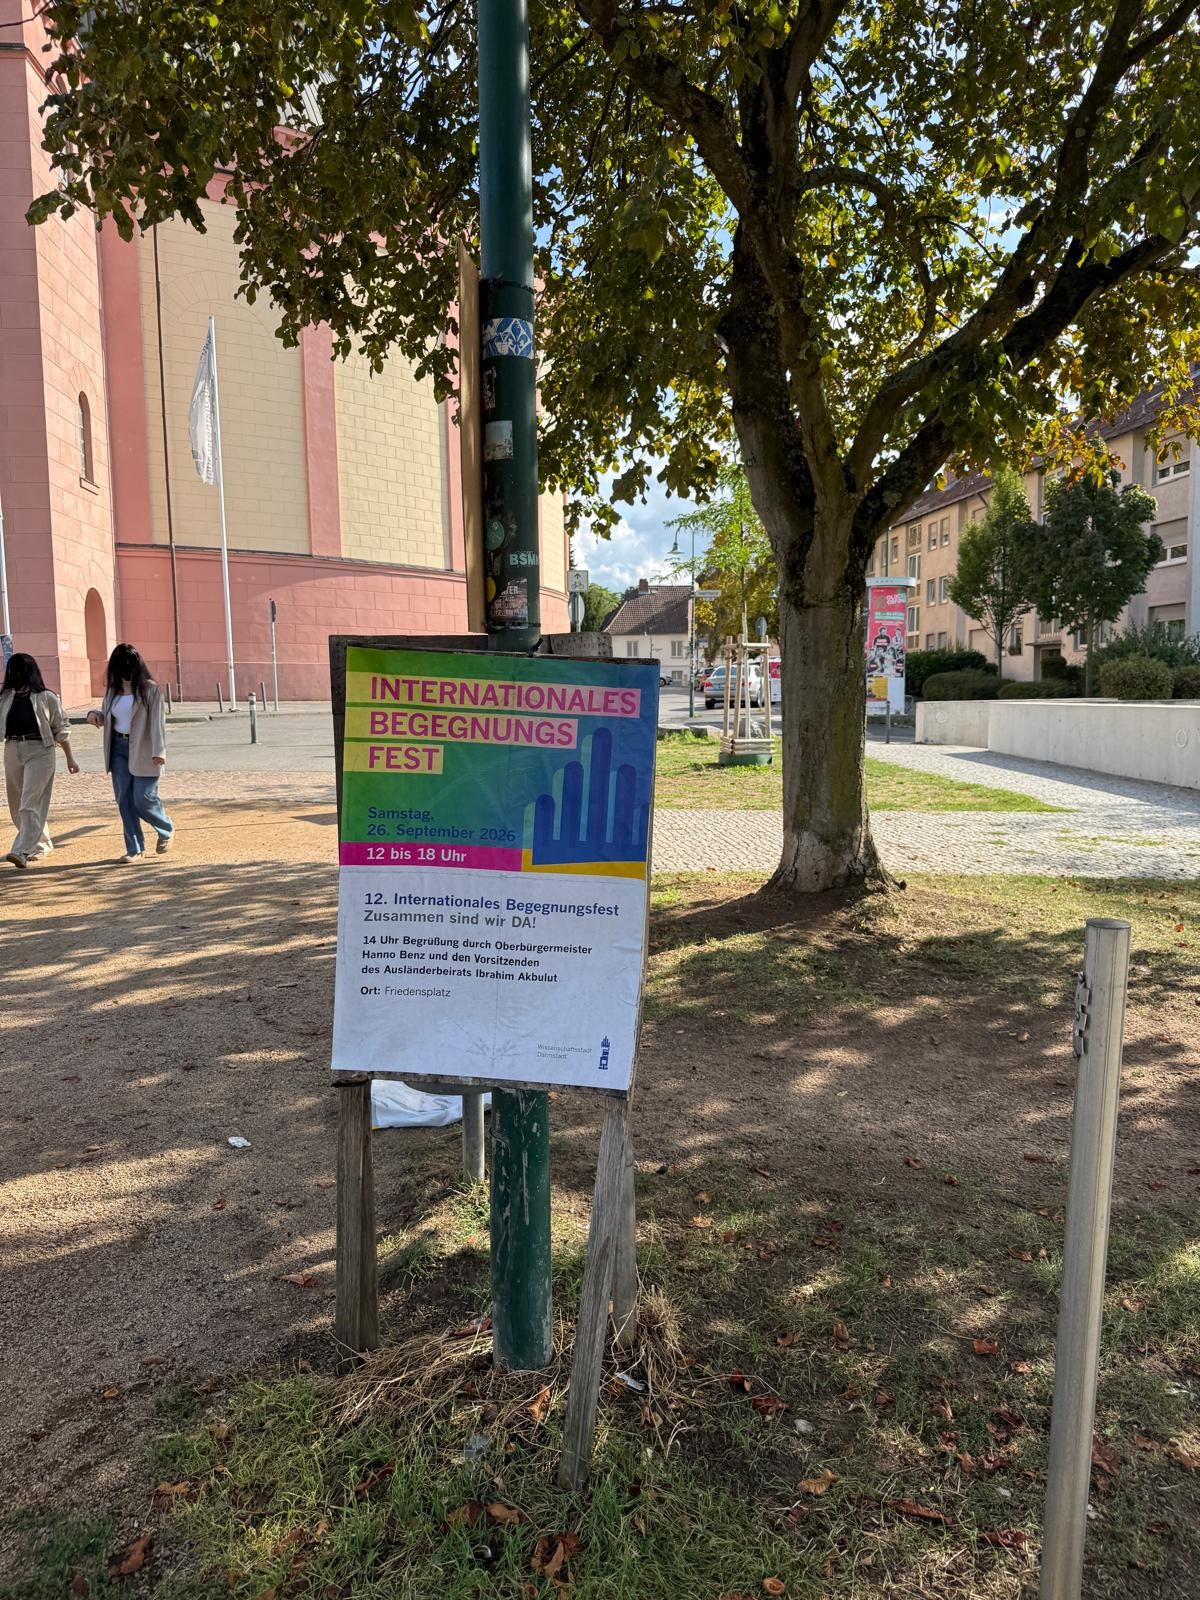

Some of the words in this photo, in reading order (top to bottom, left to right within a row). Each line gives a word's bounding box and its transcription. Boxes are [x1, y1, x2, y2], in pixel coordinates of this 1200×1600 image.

[371, 676, 637, 714] INTERNATIONALES
[370, 711, 573, 746] BEGEGNUNGS
[368, 746, 440, 770] FEST
[368, 806, 434, 823] Samstag,
[367, 824, 390, 836] 26.
[396, 824, 475, 839] September
[479, 828, 516, 842] 2026
[366, 848, 385, 860] 12
[390, 848, 412, 860] bis
[417, 848, 436, 860] 18
[441, 848, 467, 862] Uhr
[364, 892, 388, 905] 12.
[394, 892, 500, 910] Internationales
[506, 898, 619, 917] Begegnungsfest
[363, 910, 444, 923] Zusammen
[449, 912, 479, 925] sind
[484, 915, 506, 927] wir
[511, 916, 536, 929] DA!
[362, 935, 376, 945] 14
[380, 935, 400, 945] Uhr
[402, 936, 459, 949] Begrüßung
[462, 938, 492, 949] durch
[494, 941, 593, 954] Oberbürgermeister
[362, 950, 396, 959] Hanno
[399, 950, 426, 960] Benz
[429, 951, 448, 961] und
[451, 952, 471, 962] den
[474, 954, 540, 967] Vorsitzenden
[361, 965, 380, 974] des
[383, 965, 472, 977] Ausländerbeirats
[476, 969, 514, 980] Ibrahim
[518, 972, 558, 982] Akbulut
[360, 986, 381, 995] Ort:
[384, 986, 451, 998] Friedensplatz
[536, 1051, 567, 1060] Darmstadt
